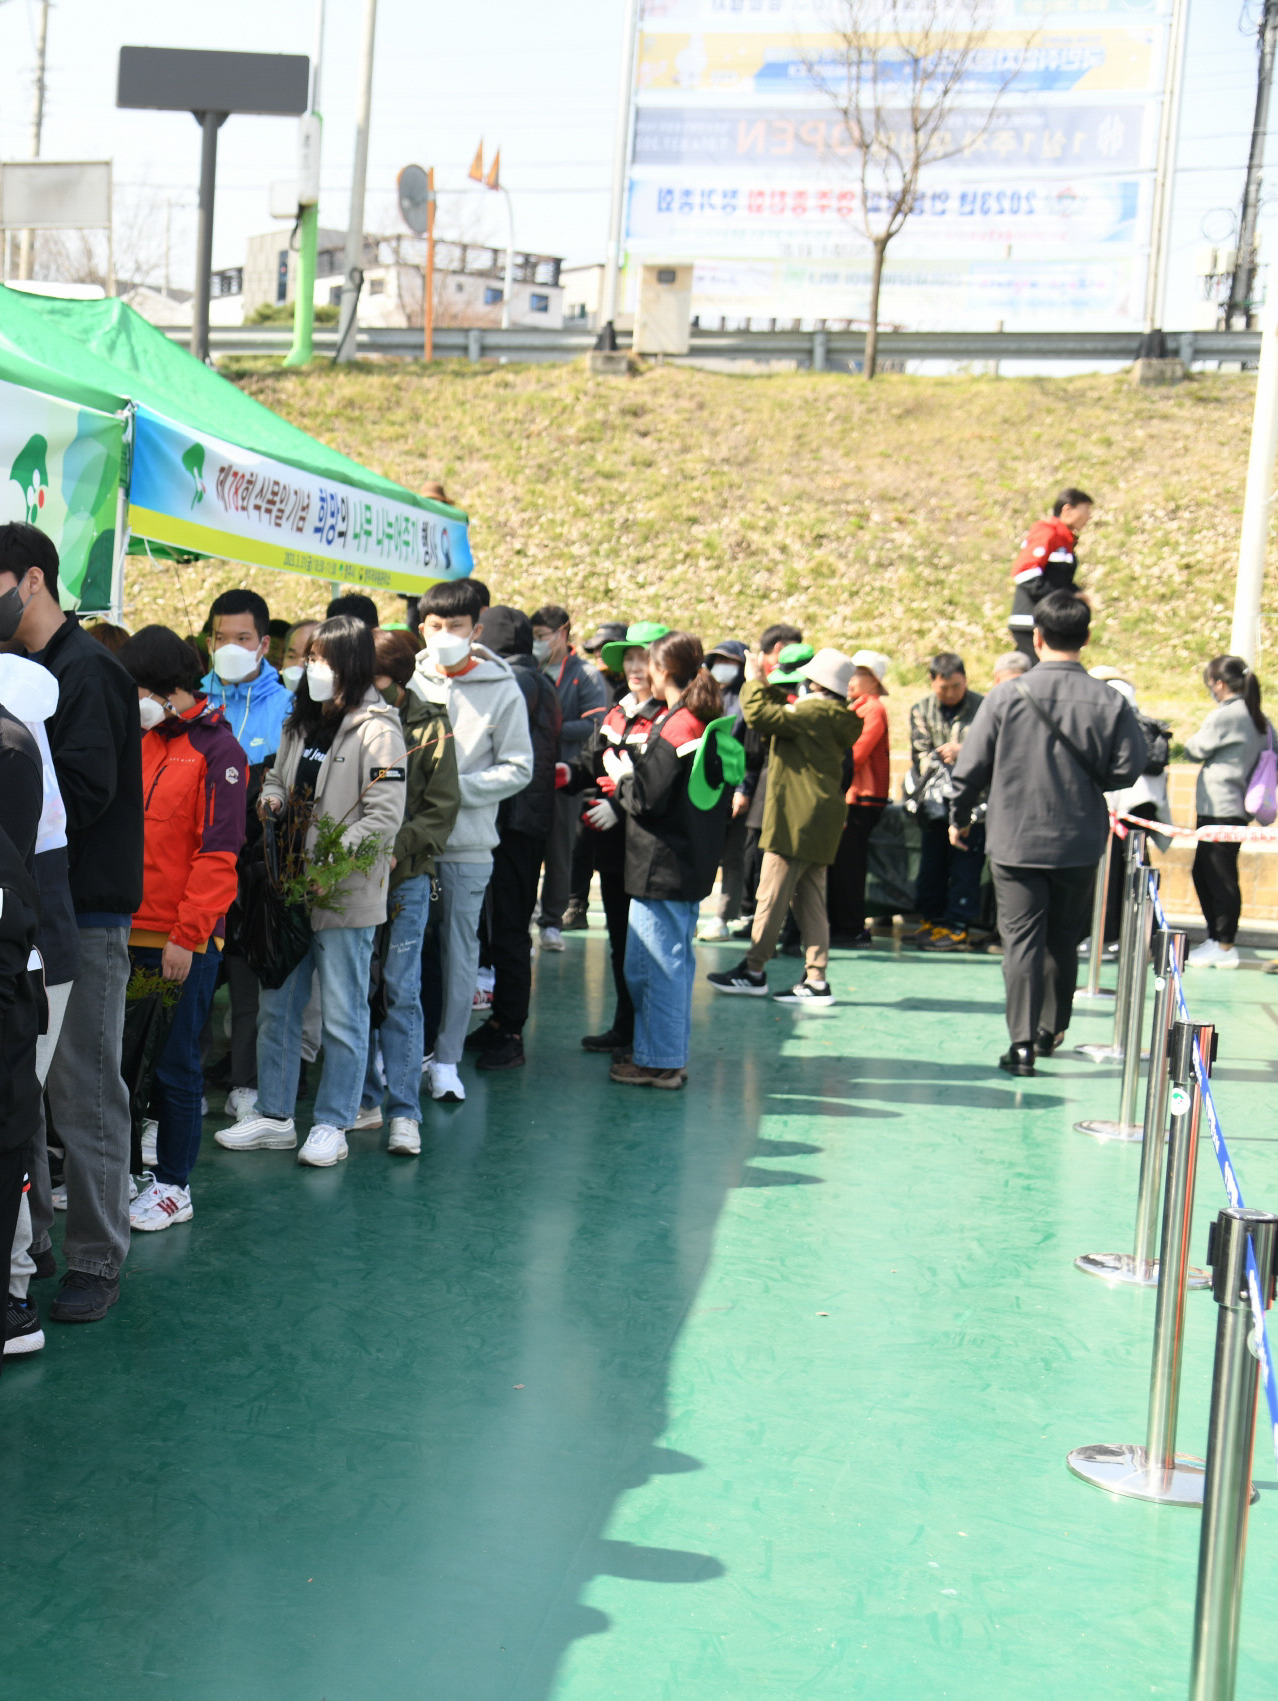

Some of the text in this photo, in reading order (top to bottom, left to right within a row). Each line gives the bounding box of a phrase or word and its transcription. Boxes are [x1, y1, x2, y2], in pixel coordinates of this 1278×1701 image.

[216, 464, 258, 521] 제78회
[313, 487, 349, 549] 희망의
[353, 500, 373, 555] 나무
[376, 506, 420, 565] 나누어주기
